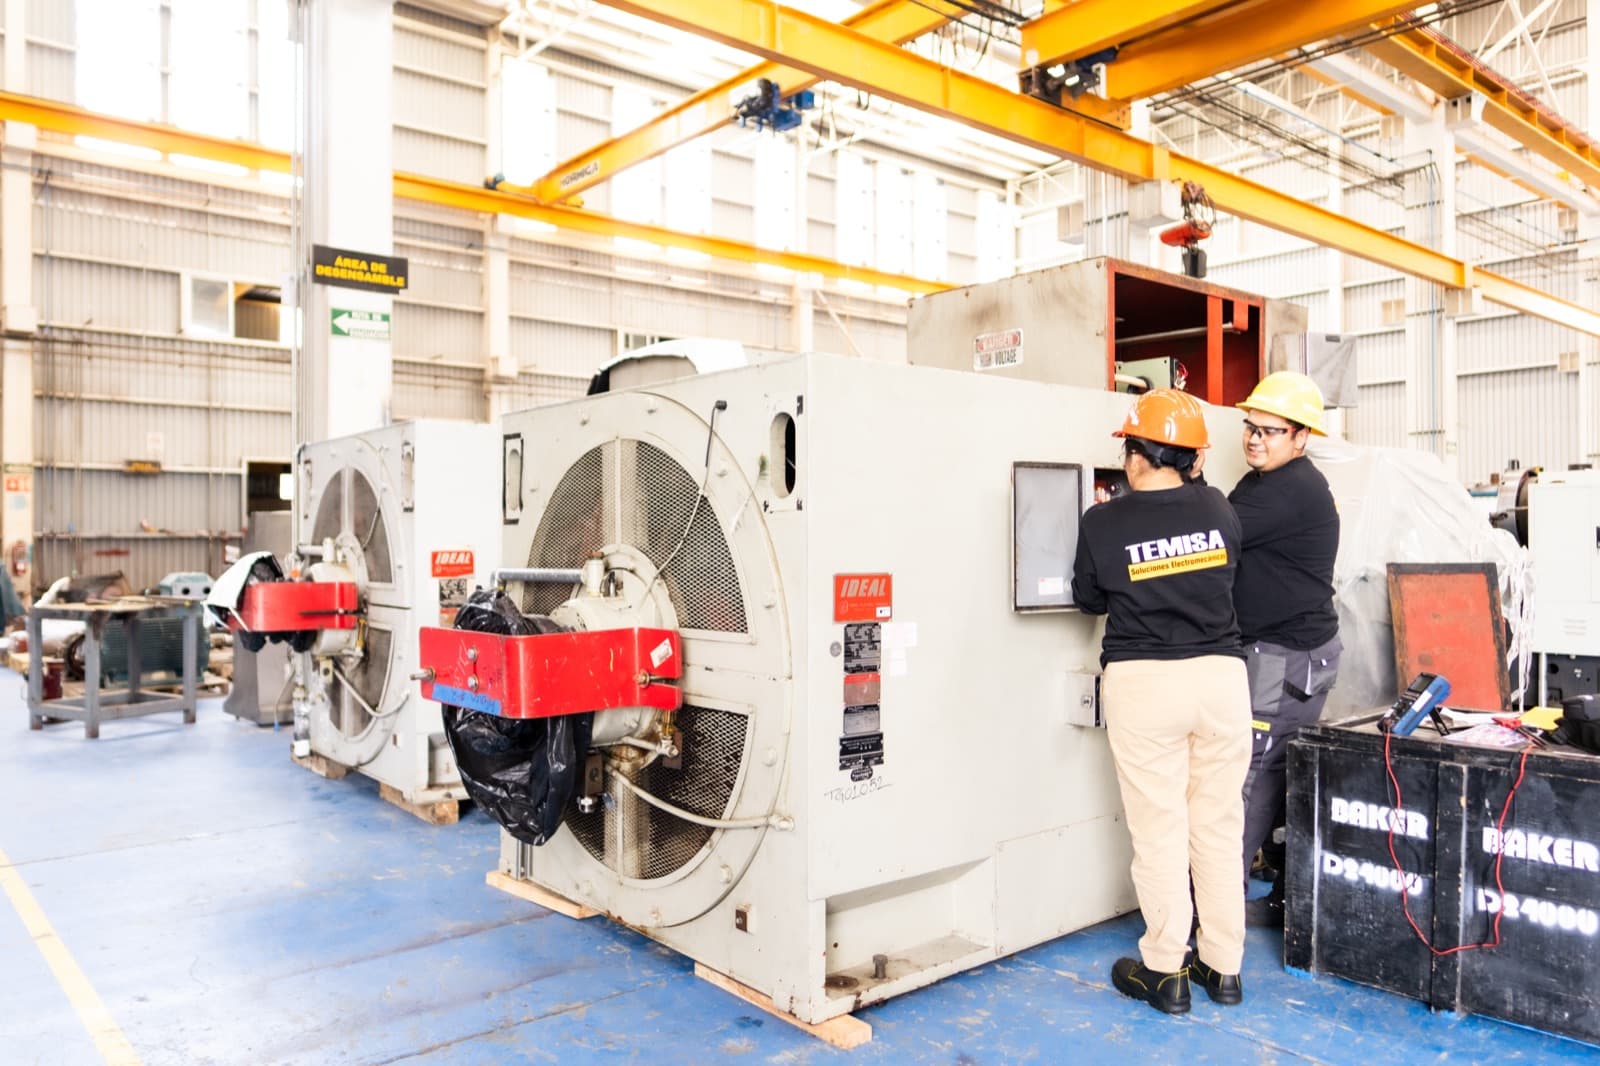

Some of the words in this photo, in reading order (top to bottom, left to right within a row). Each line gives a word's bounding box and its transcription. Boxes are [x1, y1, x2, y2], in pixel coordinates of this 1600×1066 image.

[315, 264, 405, 288] DESENSAMBLE
[370, 262, 388, 274] DE
[994, 348, 1017, 366] VOLTAGE
[1125, 529, 1225, 565] TEMISA
[434, 552, 472, 565] IDEAL
[1131, 562, 1170, 576] Soluciones
[840, 578, 887, 598] IDEAL
[1331, 797, 1429, 840] BAKER
[1482, 826, 1599, 873] BAKER
